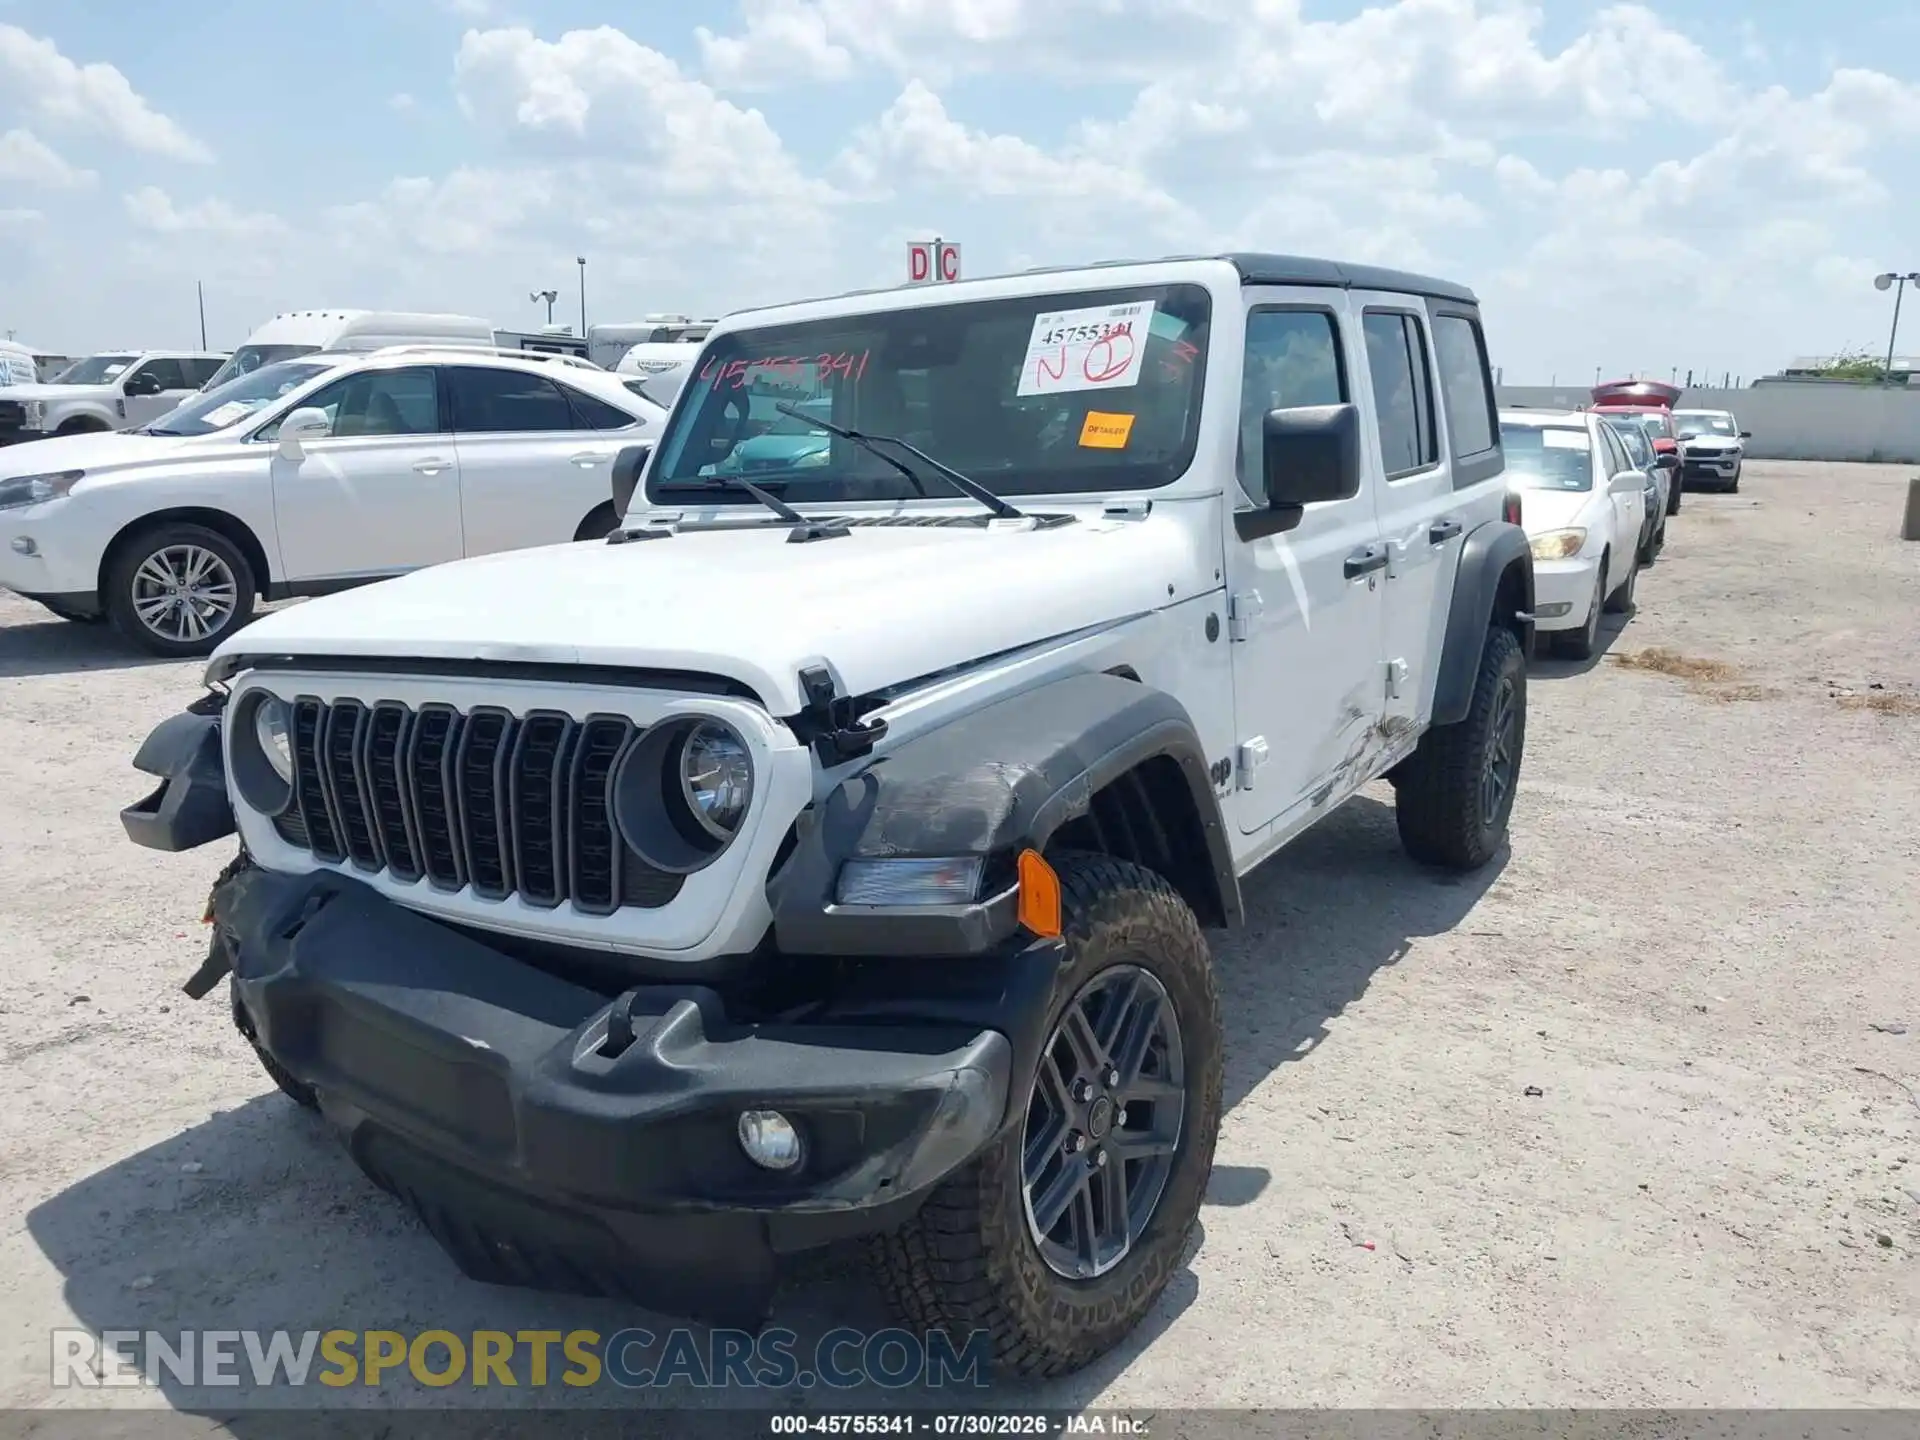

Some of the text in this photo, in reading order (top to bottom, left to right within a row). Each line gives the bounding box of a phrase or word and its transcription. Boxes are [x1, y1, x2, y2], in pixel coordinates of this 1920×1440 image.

[912, 248, 927, 280] D
[943, 248, 957, 280] C
[1041, 320, 1133, 345] 45755341
